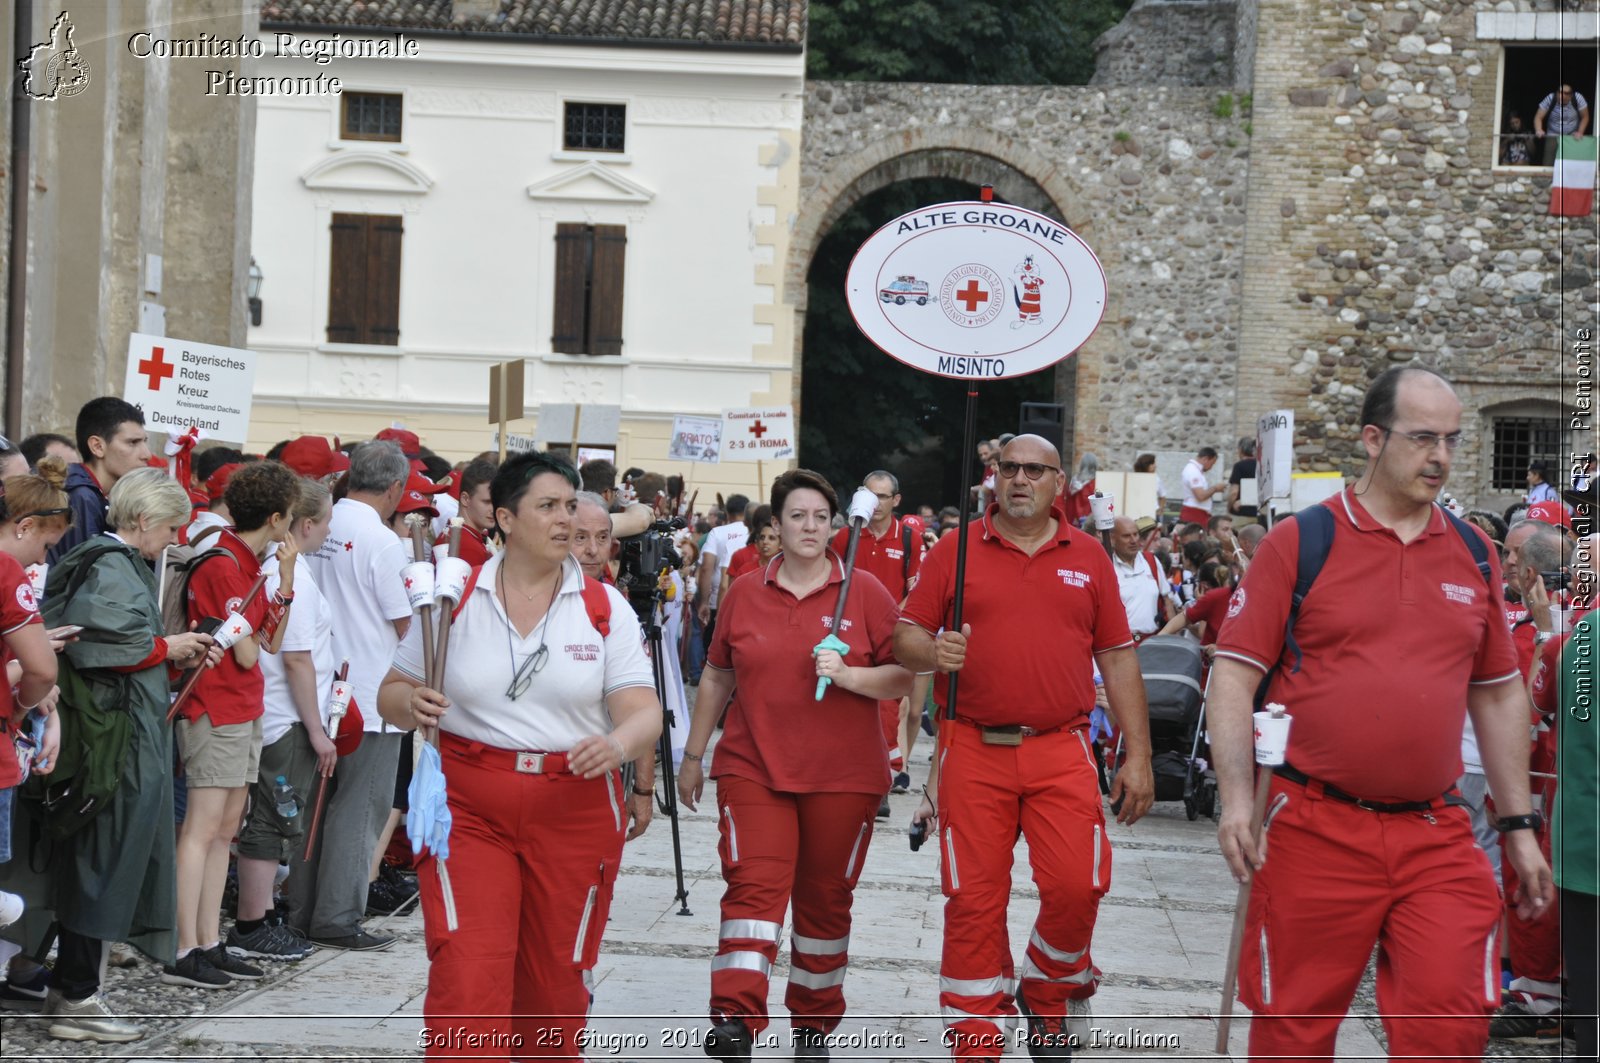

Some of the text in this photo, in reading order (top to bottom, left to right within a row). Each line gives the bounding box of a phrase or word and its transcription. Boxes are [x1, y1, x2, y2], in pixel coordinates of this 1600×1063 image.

[896, 211, 1068, 245] ALTE GROANE
[951, 270, 961, 281] DI
[960, 265, 992, 281] GINEVRA
[988, 287, 1002, 317] AGOSTO
[182, 350, 246, 370] Bayerisches
[937, 356, 1005, 377] MISINTO
[180, 367, 210, 382] Rotes
[177, 384, 209, 398] Kreuz
[176, 400, 241, 415] Kreisverband Dachau
[727, 410, 788, 420] Comitato Locale
[152, 411, 220, 431] Deutschland
[747, 440, 757, 449] di
[760, 439, 789, 448] ROMA
[564, 644, 583, 653] CROCE
[573, 653, 597, 661] ITALIANA
